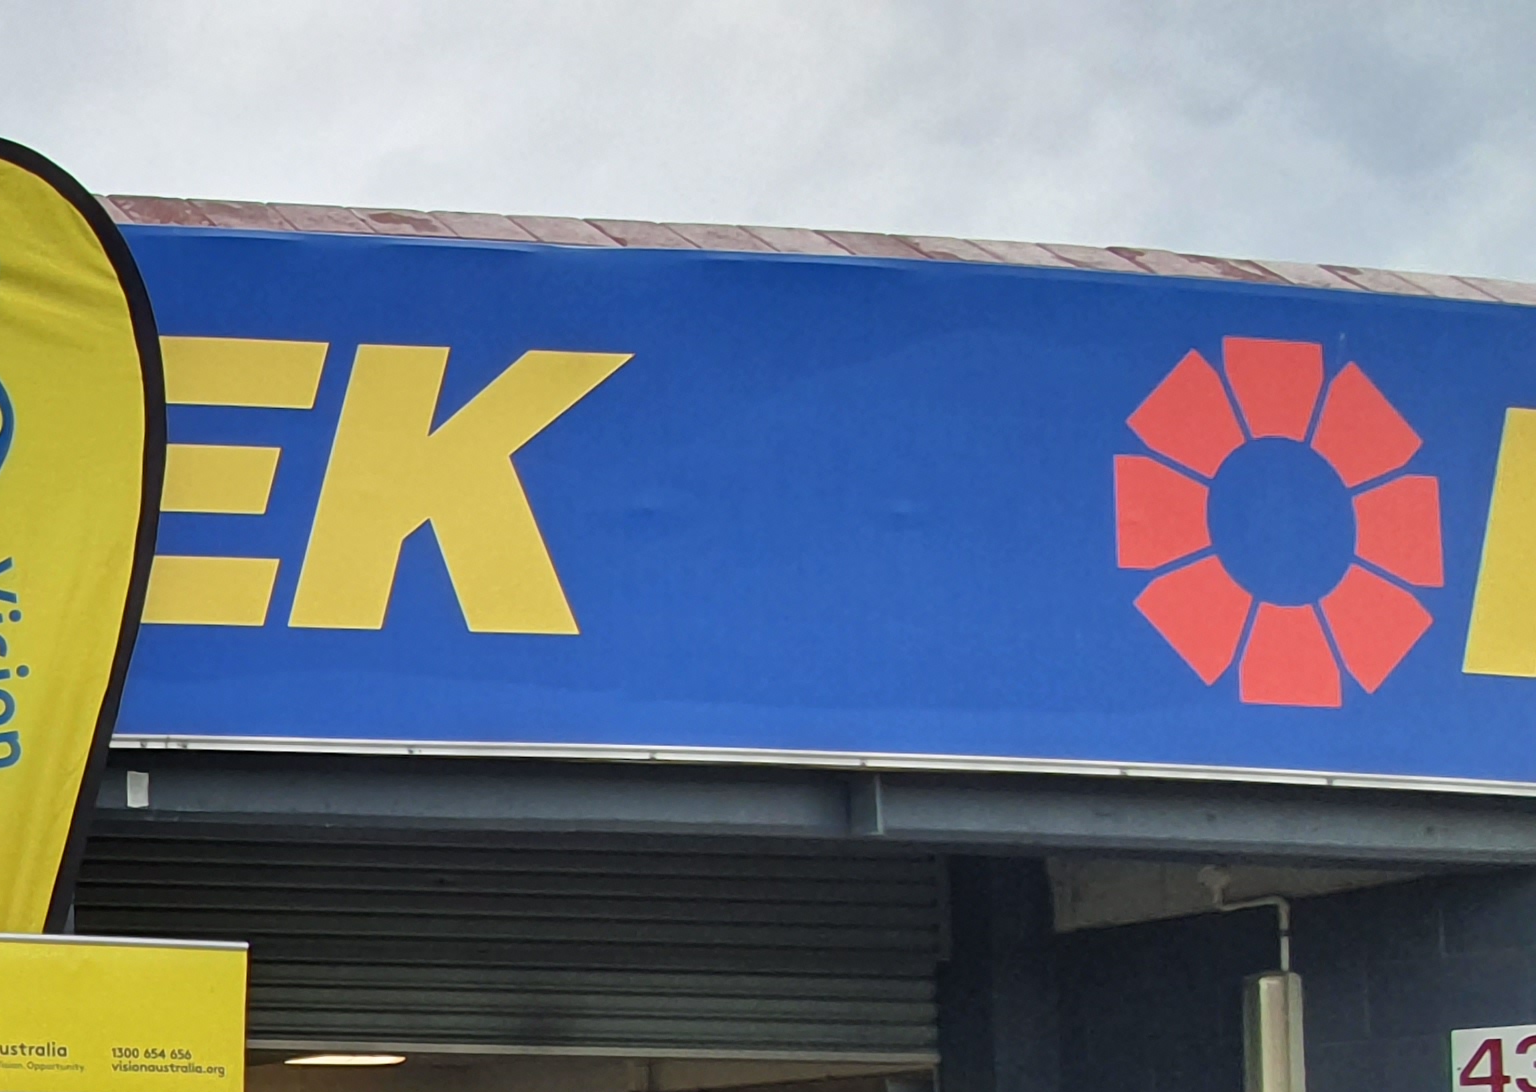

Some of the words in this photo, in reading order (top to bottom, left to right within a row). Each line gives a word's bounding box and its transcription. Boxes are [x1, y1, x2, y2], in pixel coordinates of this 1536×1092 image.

[111, 1047, 140, 1059] 1300
[143, 1048, 166, 1059] 654
[169, 1048, 192, 1061] 656
[111, 1060, 226, 1077] visionaustralia.org
